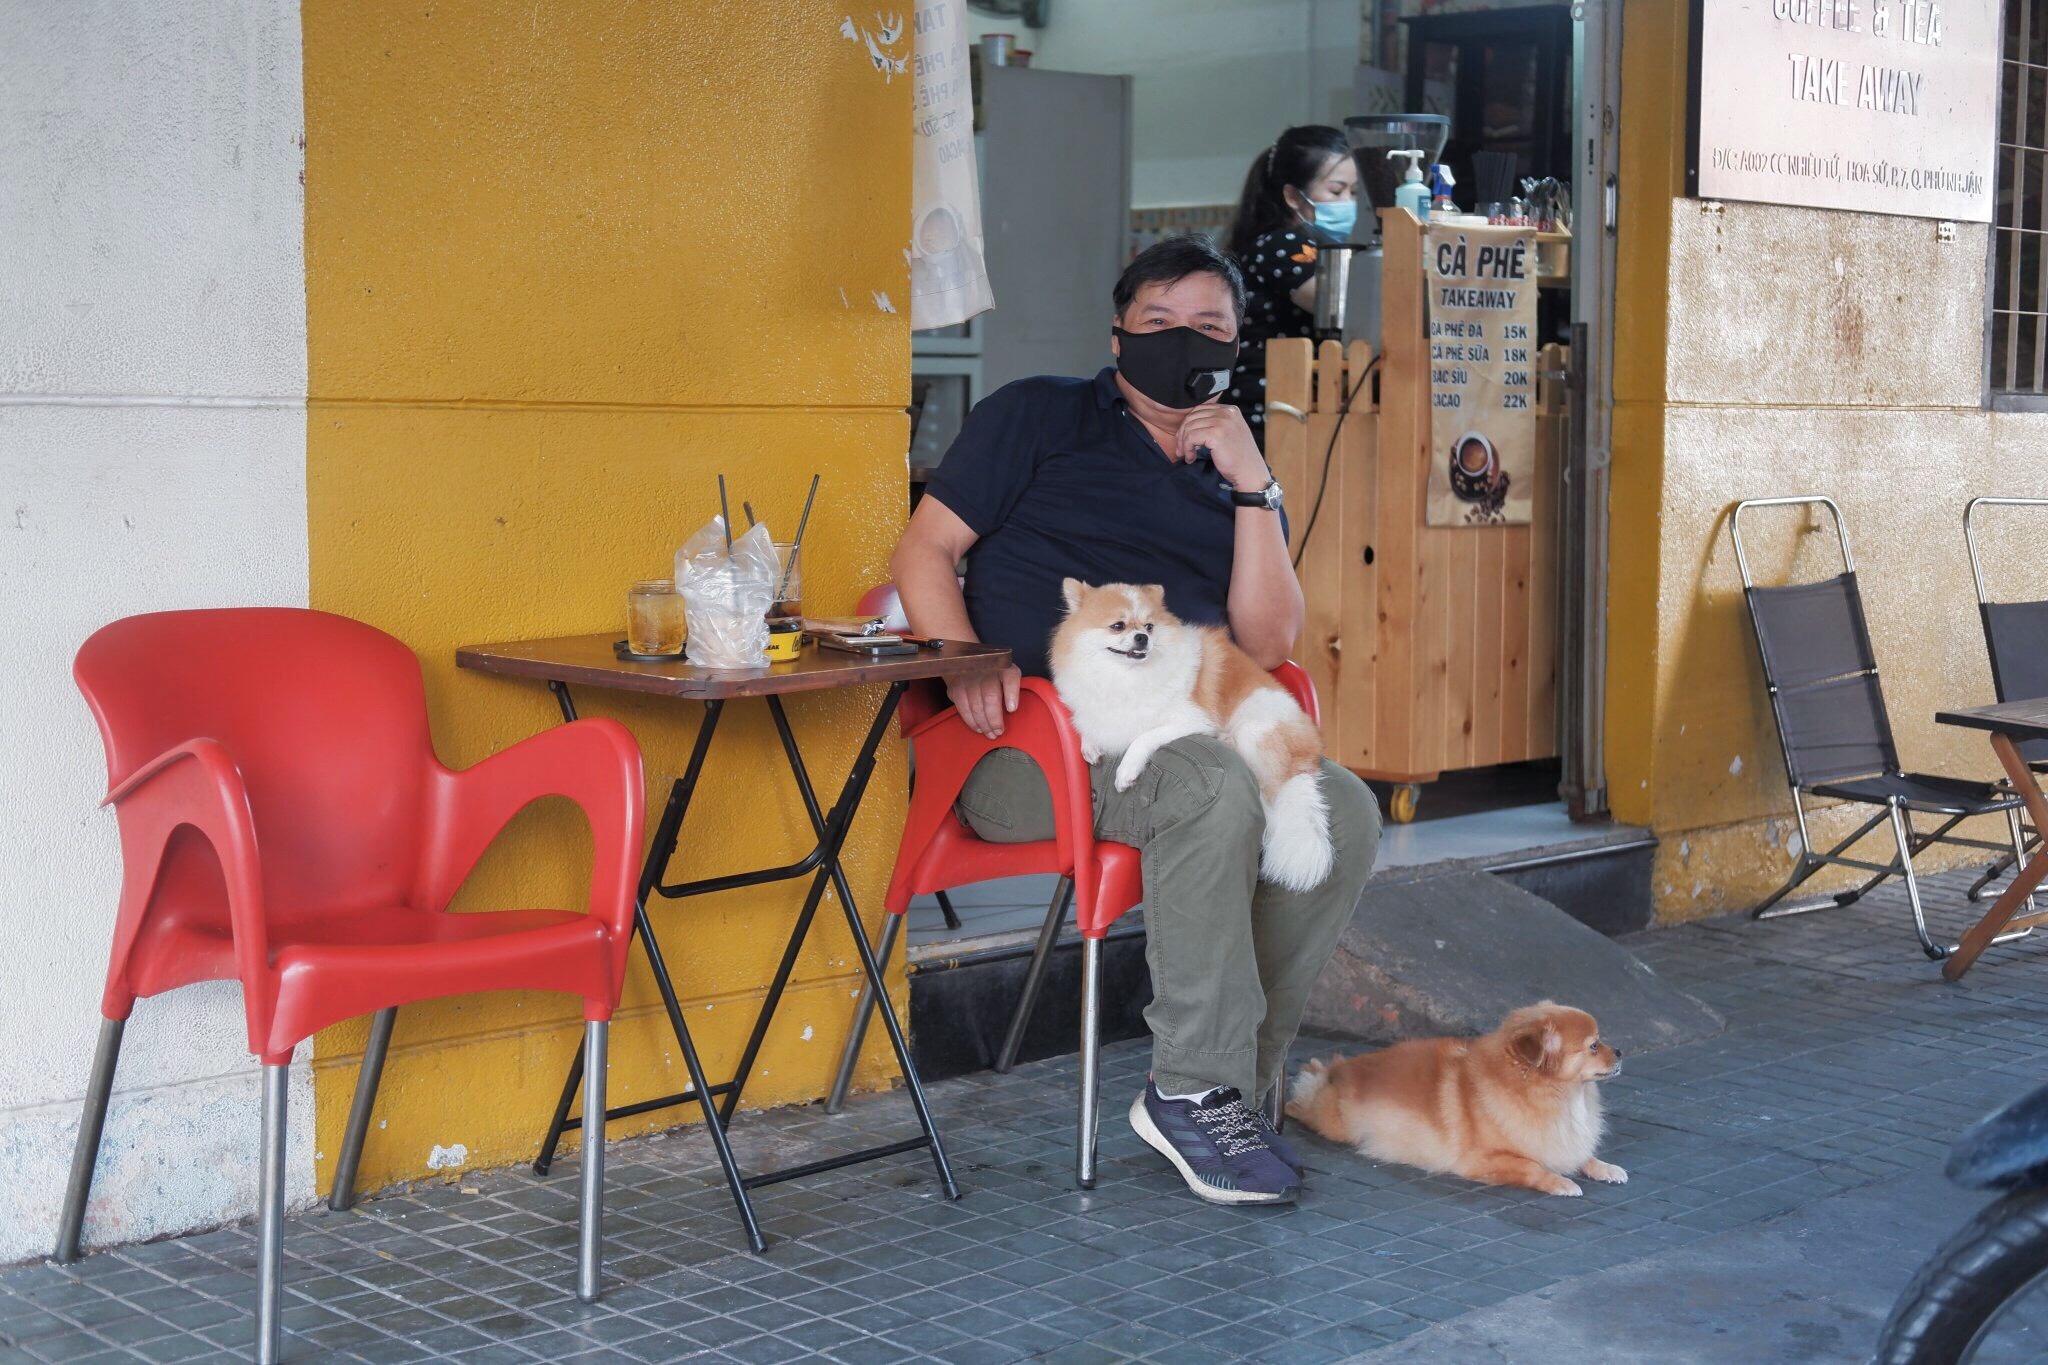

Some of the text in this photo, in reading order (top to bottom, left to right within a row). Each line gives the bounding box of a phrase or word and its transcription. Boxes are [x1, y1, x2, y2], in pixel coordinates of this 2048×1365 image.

[1873, 0, 1890, 38] &
[1900, 0, 1942, 47] TEA
[1788, 53, 1922, 116] TAKE AWAY
[1846, 160, 1870, 182] HOA
[1923, 166, 1945, 191] PHÚ
[1437, 236, 1526, 279] CÀ PHÊ
[1441, 288, 1516, 309] TAKEAWAY
[1445, 320, 1465, 338] PHÊ
[1504, 325, 1528, 339] 15K
[1445, 344, 1464, 361] PHÊ
[1504, 348, 1528, 362] 18K
[1504, 371, 1528, 385] 20K
[1503, 394, 1528, 408] 22K
